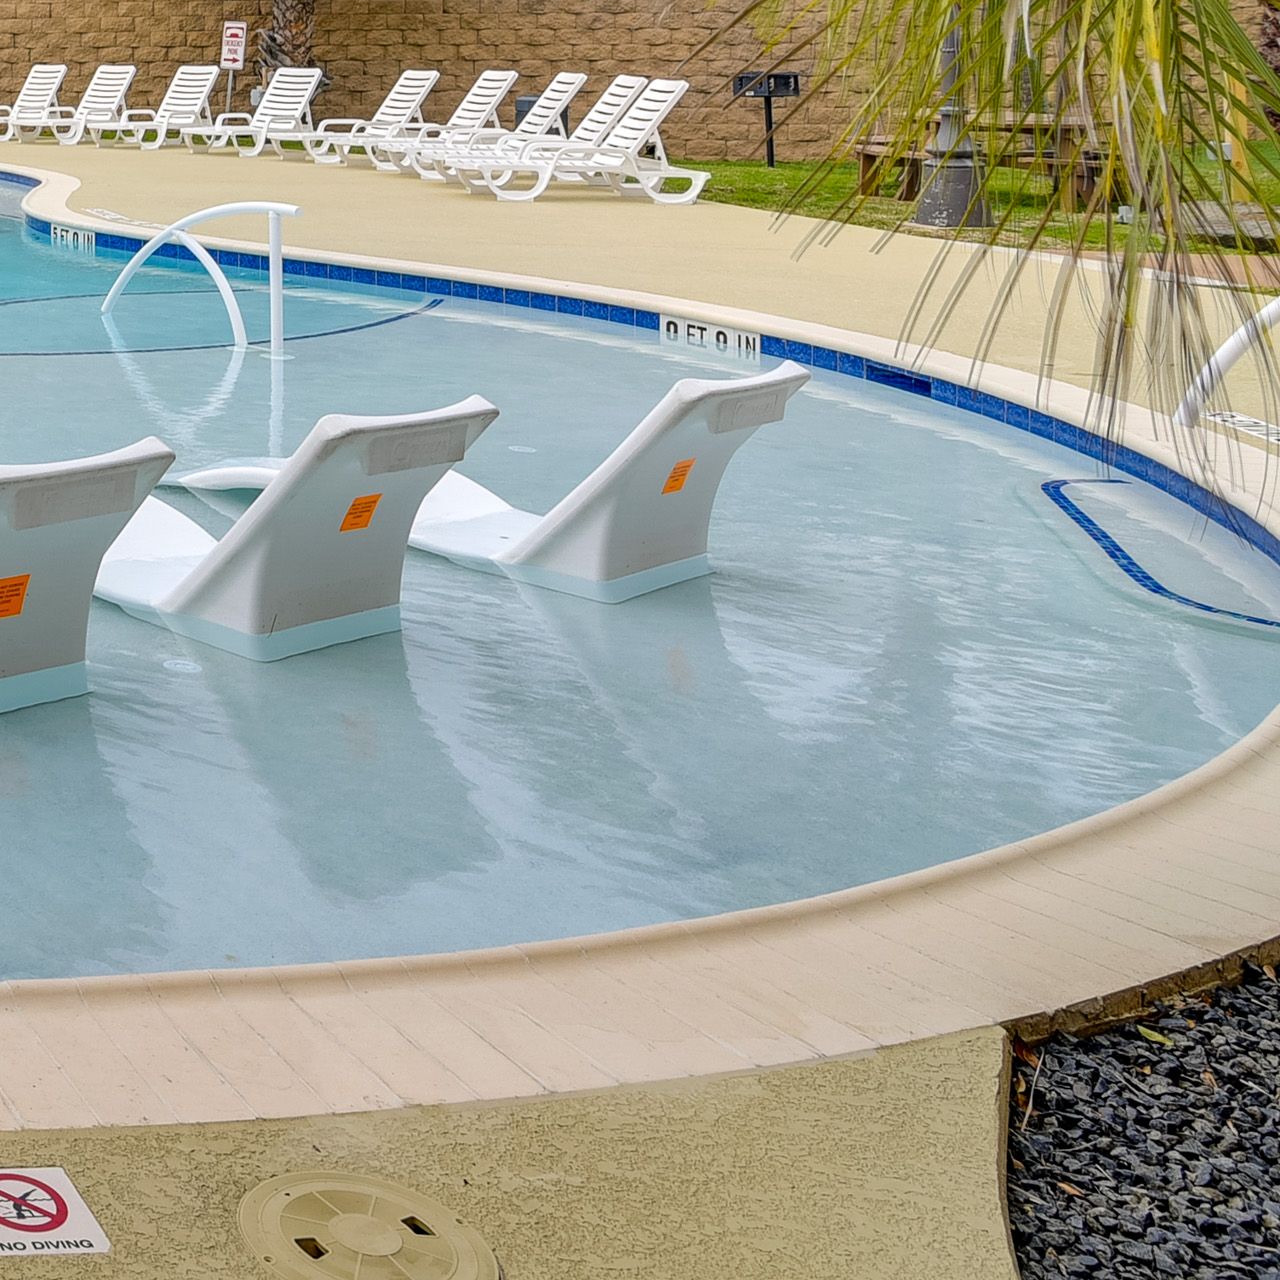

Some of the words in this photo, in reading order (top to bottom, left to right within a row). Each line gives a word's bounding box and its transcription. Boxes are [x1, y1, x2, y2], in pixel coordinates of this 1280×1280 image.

[61, 228, 69, 243] FT
[83, 232, 93, 248] IN
[687, 323, 707, 342] FT
[738, 334, 756, 353] IN
[31, 1238, 95, 1251] DIVING
